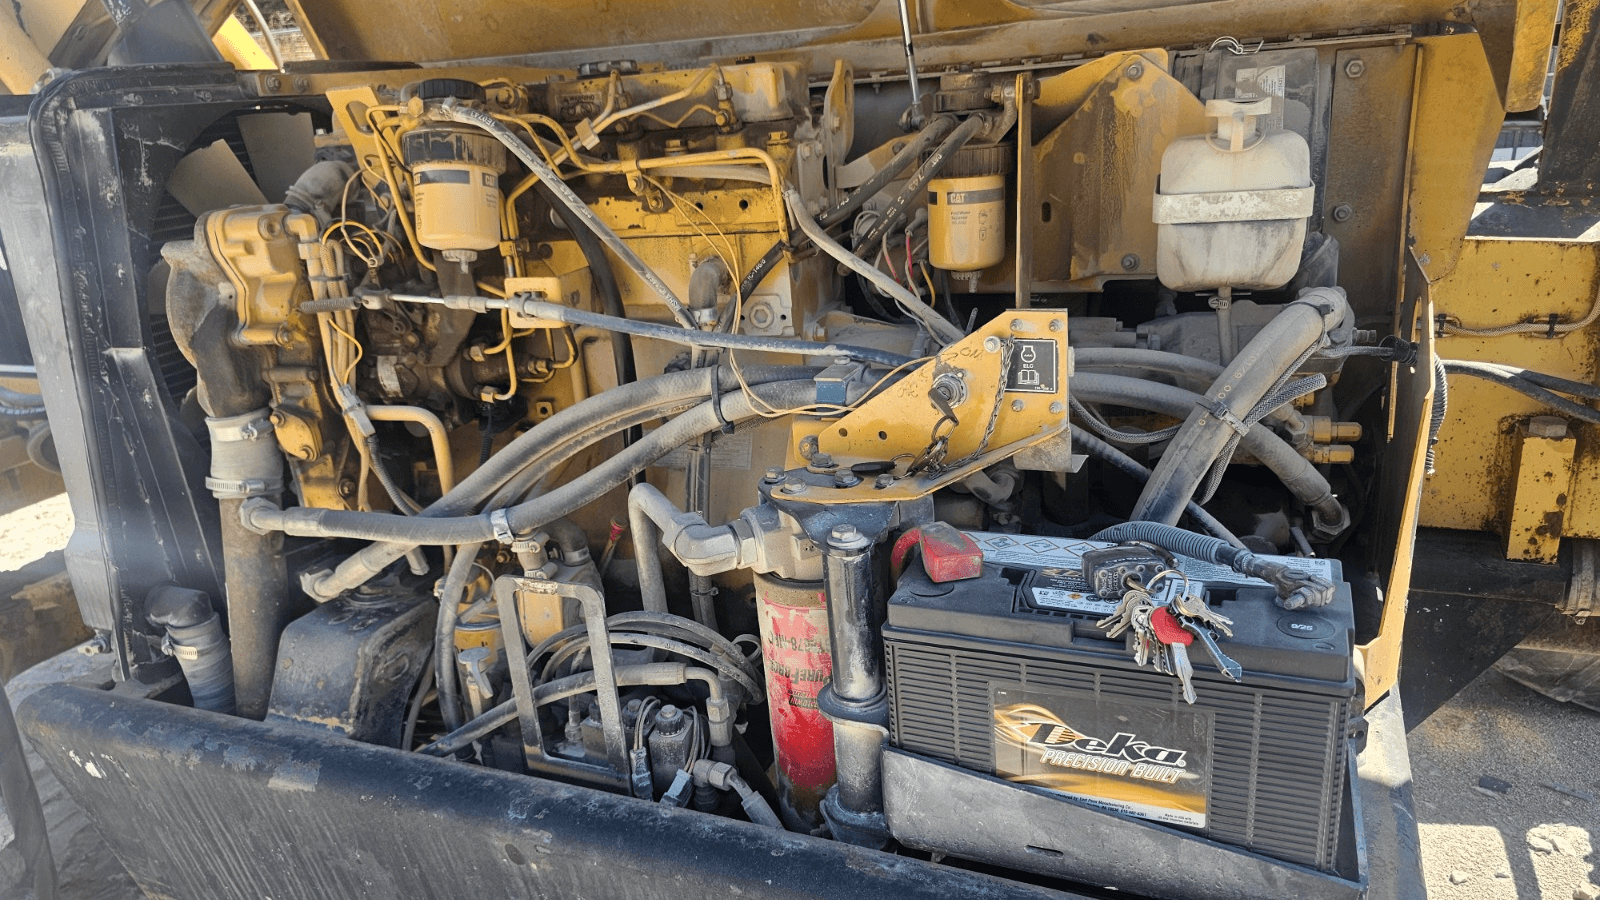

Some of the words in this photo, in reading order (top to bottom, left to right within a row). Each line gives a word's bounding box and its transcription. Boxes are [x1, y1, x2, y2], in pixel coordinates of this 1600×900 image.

[485, 174, 496, 186] CAT
[908, 175, 925, 192] 743
[560, 185, 574, 202] 743
[950, 193, 966, 204] CAT
[666, 292, 682, 312] MSHA
[1026, 722, 1187, 766] Deka
[1040, 748, 1130, 776] PRECISION
[1130, 763, 1186, 784] BUILT
